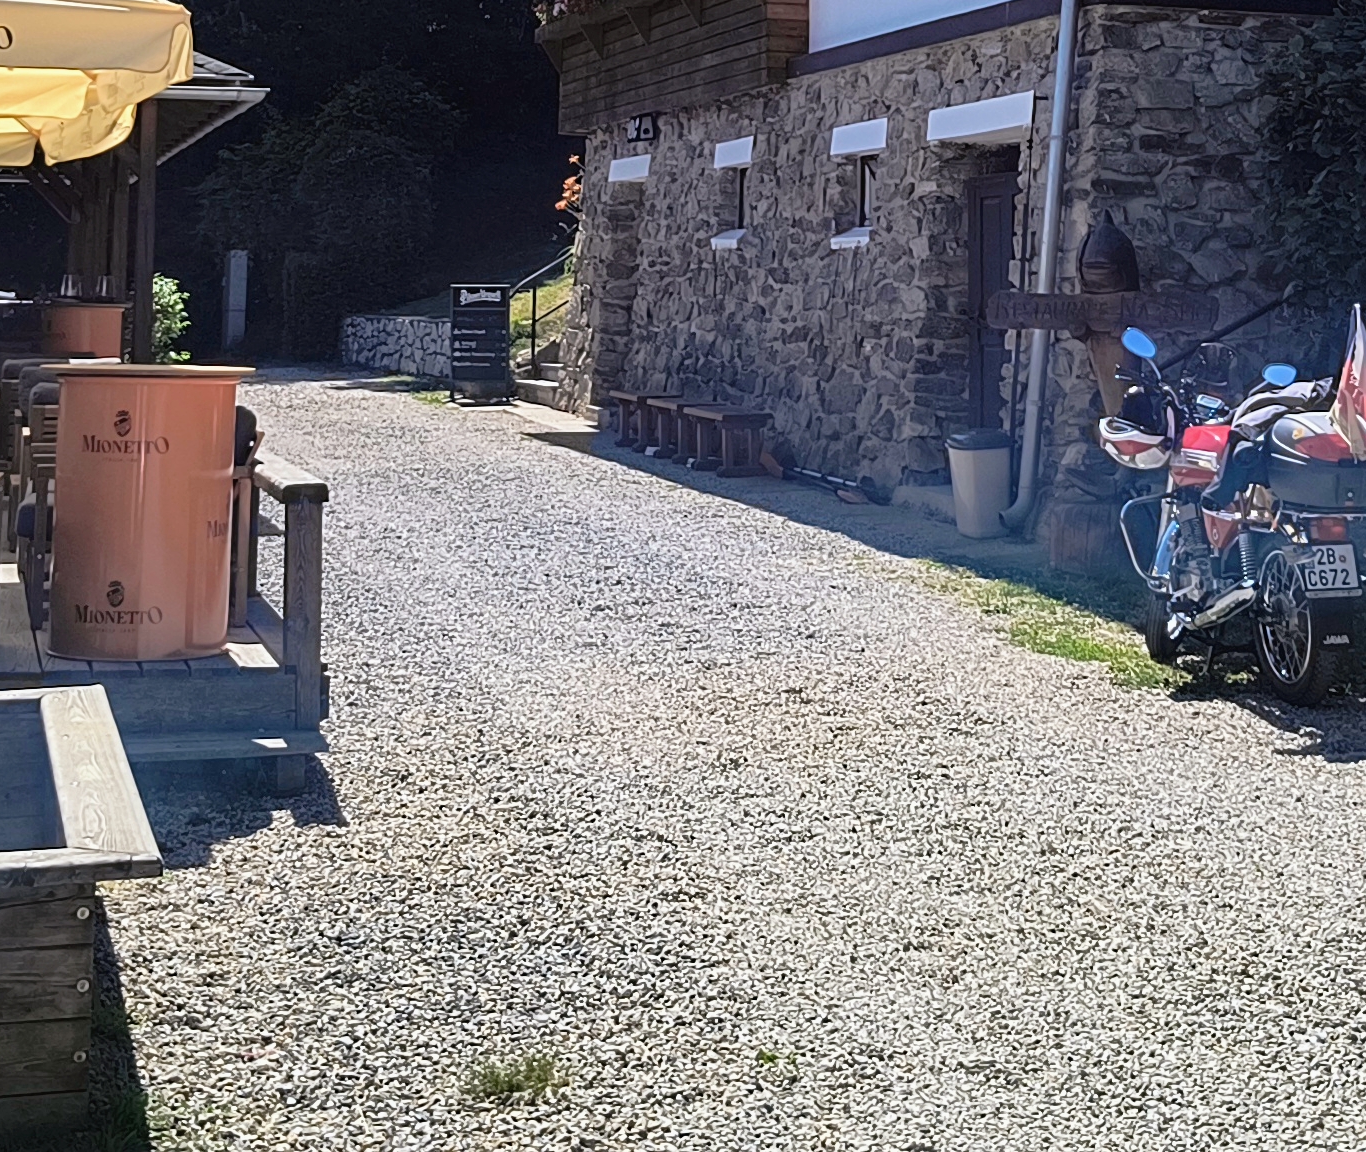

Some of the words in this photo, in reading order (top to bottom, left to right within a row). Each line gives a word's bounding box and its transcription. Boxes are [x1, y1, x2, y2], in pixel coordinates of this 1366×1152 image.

[82, 435, 170, 455] MIONETTO
[1316, 548, 1336, 565] 2B
[1308, 568, 1351, 587] C672
[75, 604, 163, 625] MIONETTO
